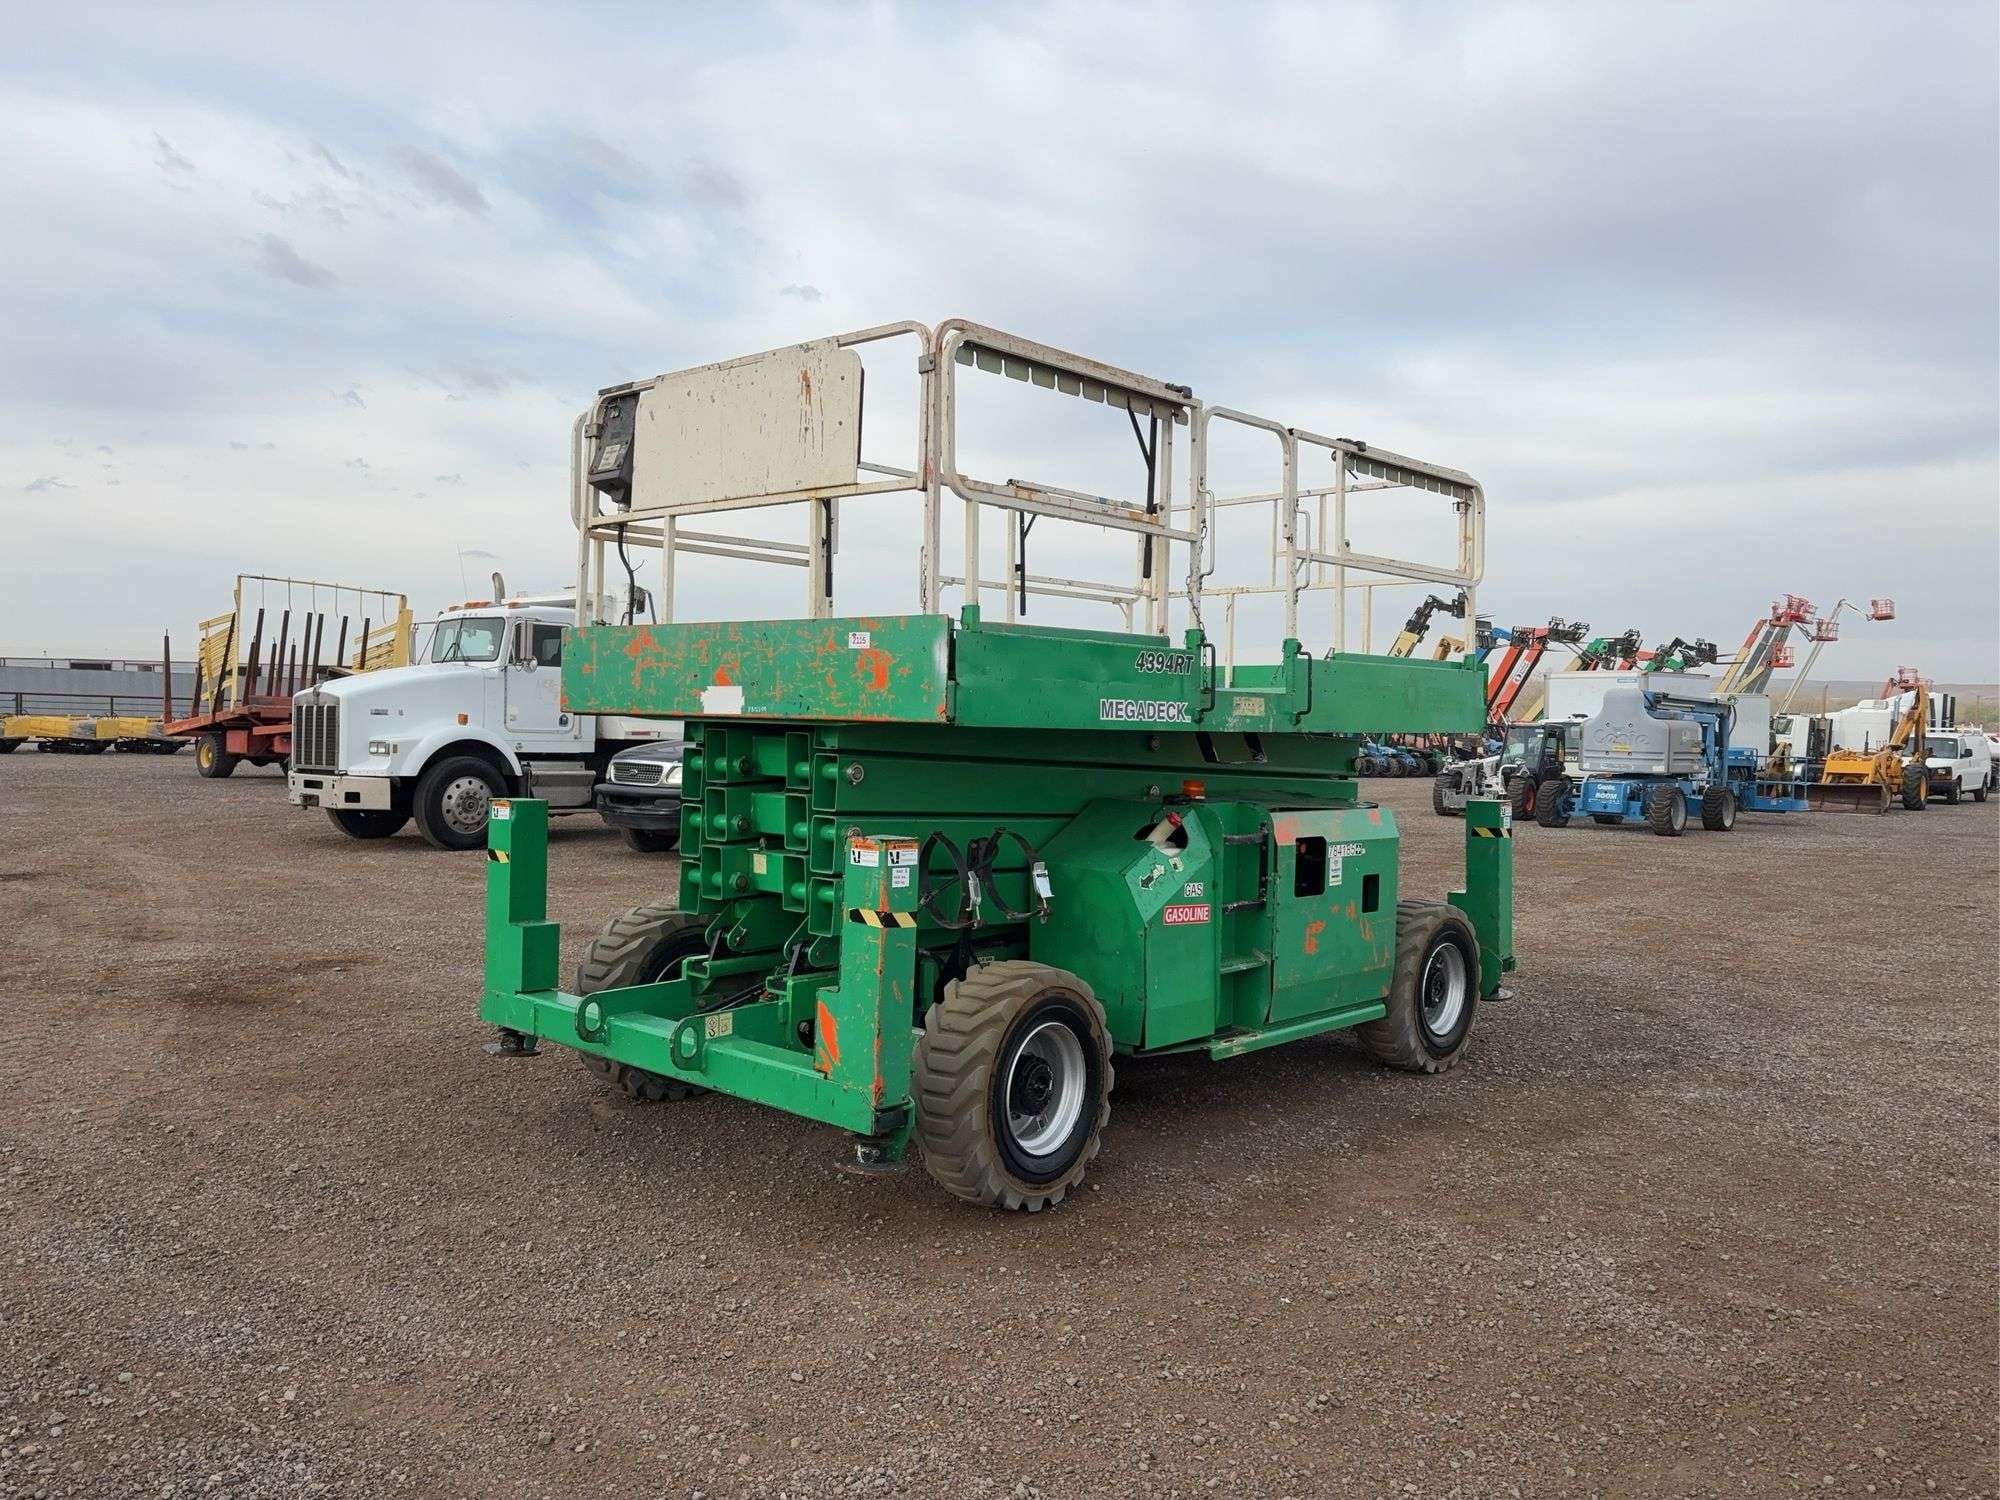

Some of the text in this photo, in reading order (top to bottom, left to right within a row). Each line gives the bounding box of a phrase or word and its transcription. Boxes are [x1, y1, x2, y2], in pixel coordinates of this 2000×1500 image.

[1135, 651, 1194, 675] 4394RT
[1100, 699, 1190, 722] MEGADECK
[1185, 883, 1203, 896] GAS
[1165, 907, 1209, 922] GASOLINE
